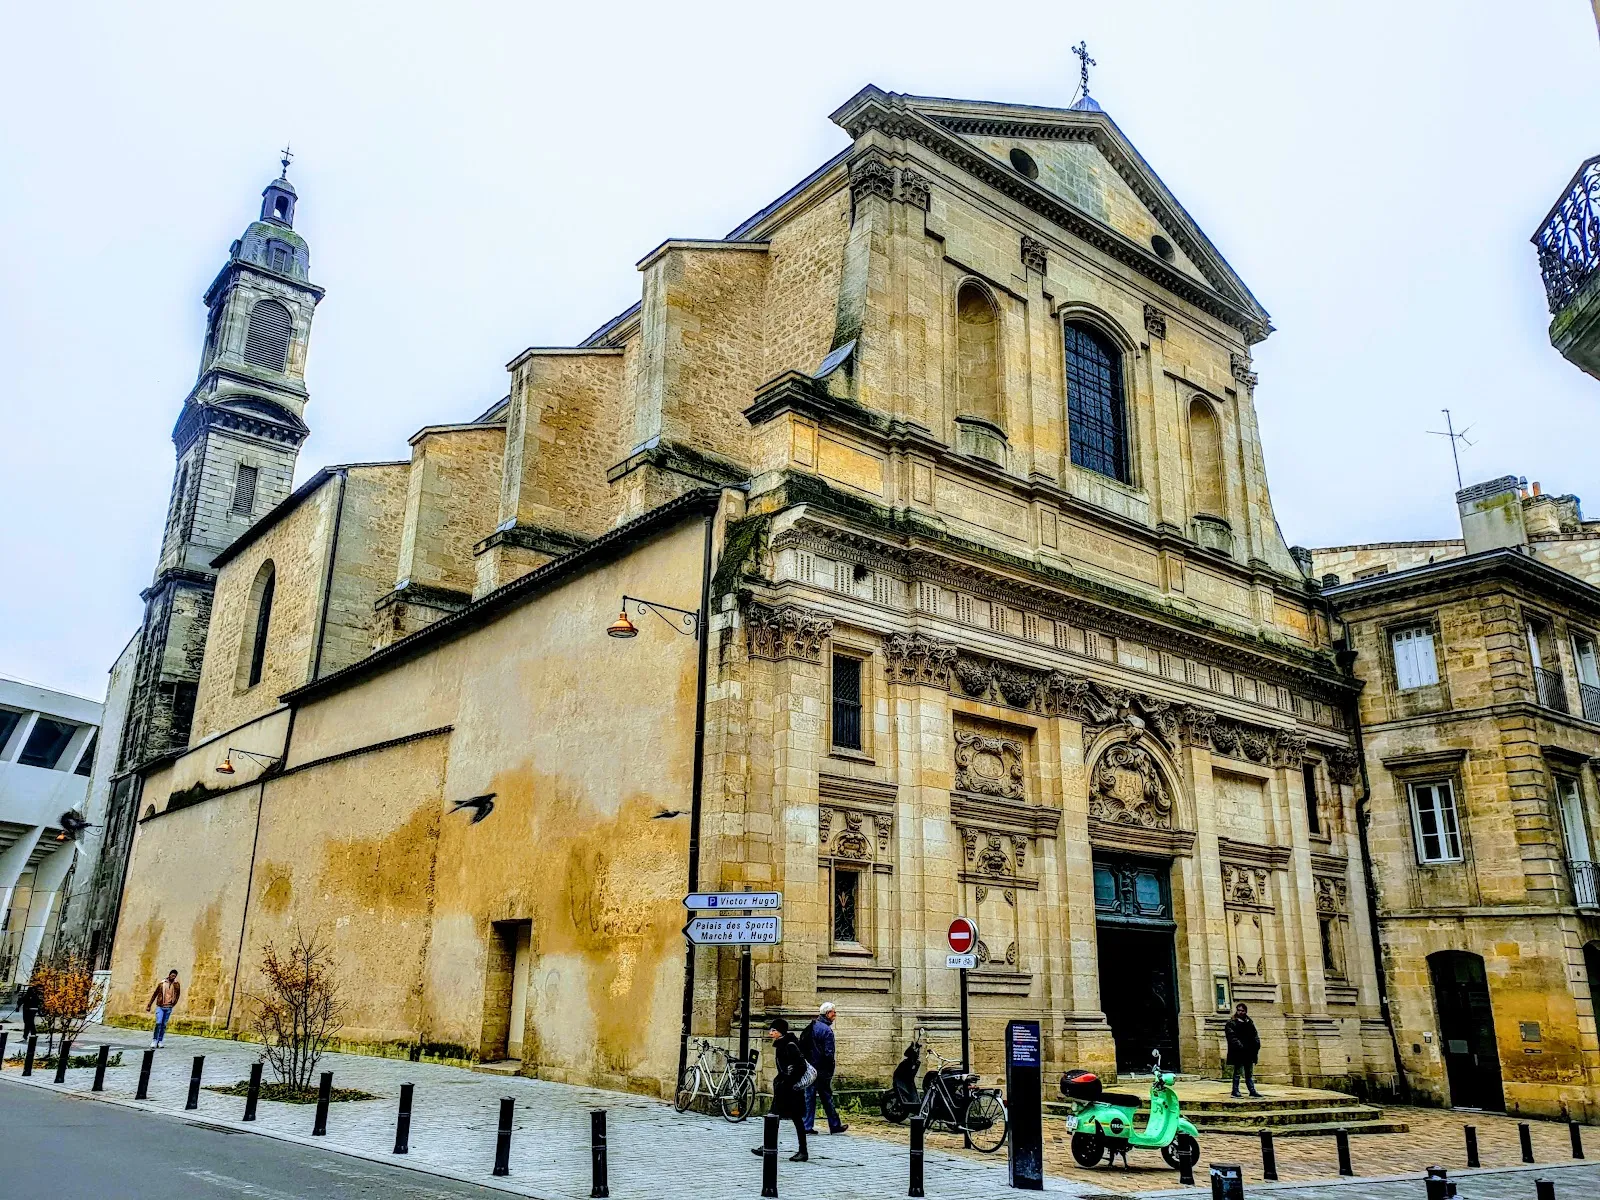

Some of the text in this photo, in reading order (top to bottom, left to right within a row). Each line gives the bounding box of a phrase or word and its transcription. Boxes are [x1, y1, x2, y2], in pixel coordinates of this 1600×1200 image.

[709, 897, 775, 907] P Victor Hugo
[695, 921, 774, 931] Palais des Sports
[701, 931, 773, 941] Marché V. Hugo
